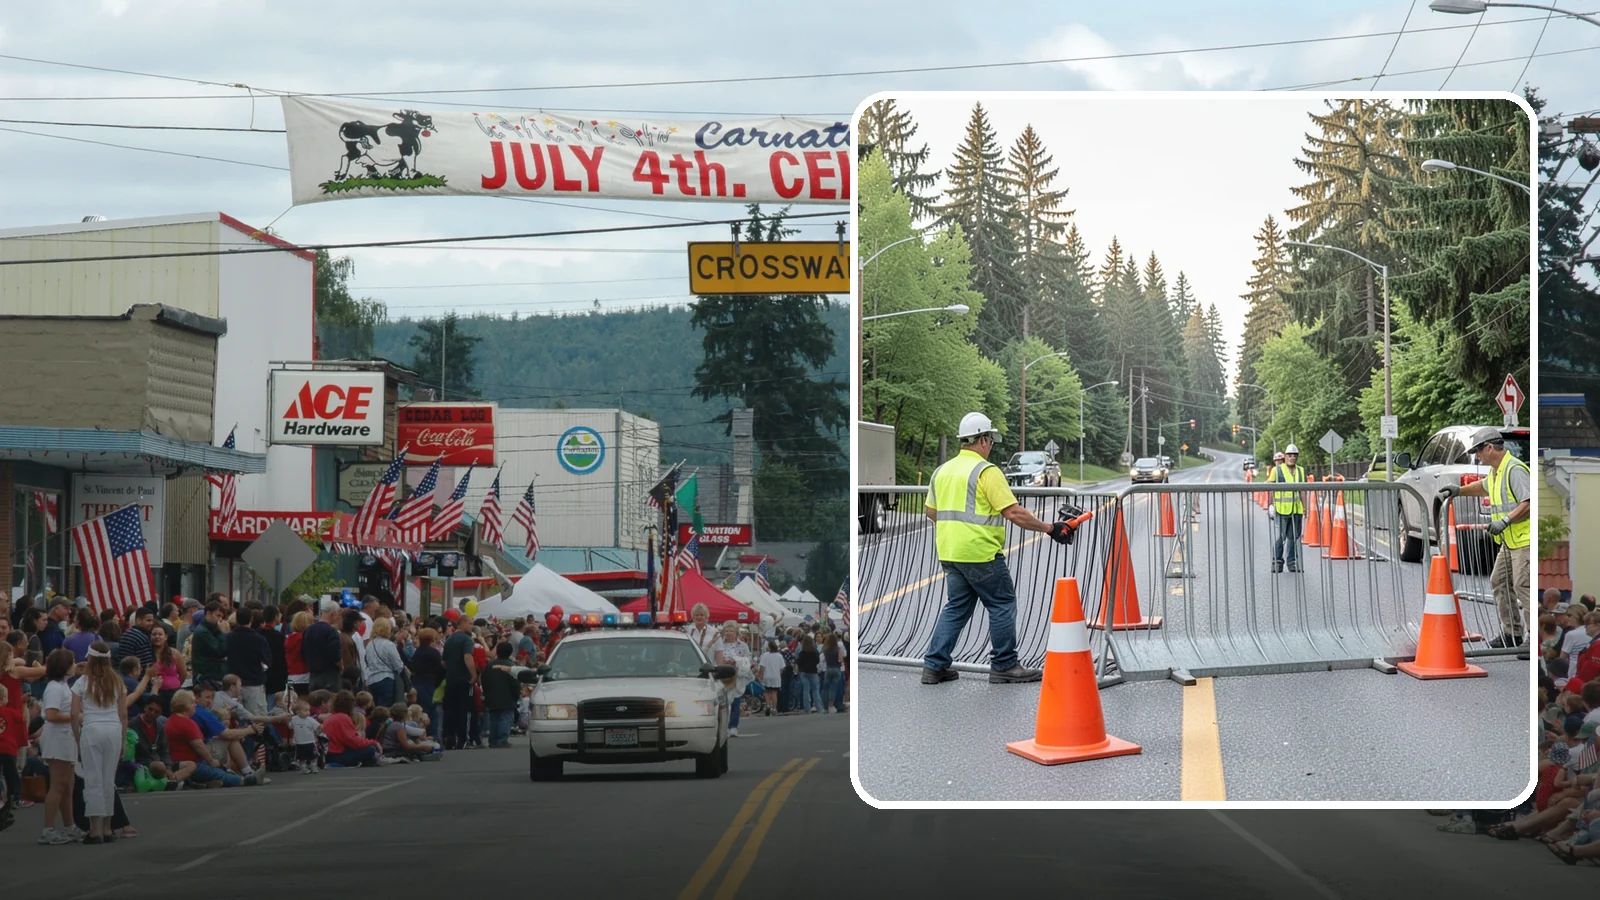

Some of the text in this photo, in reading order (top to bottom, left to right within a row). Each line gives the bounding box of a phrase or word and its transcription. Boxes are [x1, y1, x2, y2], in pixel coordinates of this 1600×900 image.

[481, 141, 604, 192] JULY
[632, 150, 747, 197] 4th.
[697, 254, 850, 280] CROSSWA
[283, 380, 373, 420] ACE
[406, 409, 452, 422] CEDAR
[283, 421, 371, 436] Hardware
[416, 428, 477, 447] Coca-Cola
[83, 485, 155, 495] St. Vincent de Paul
[688, 526, 741, 535] CRNATION
[699, 535, 730, 543] GLASS
